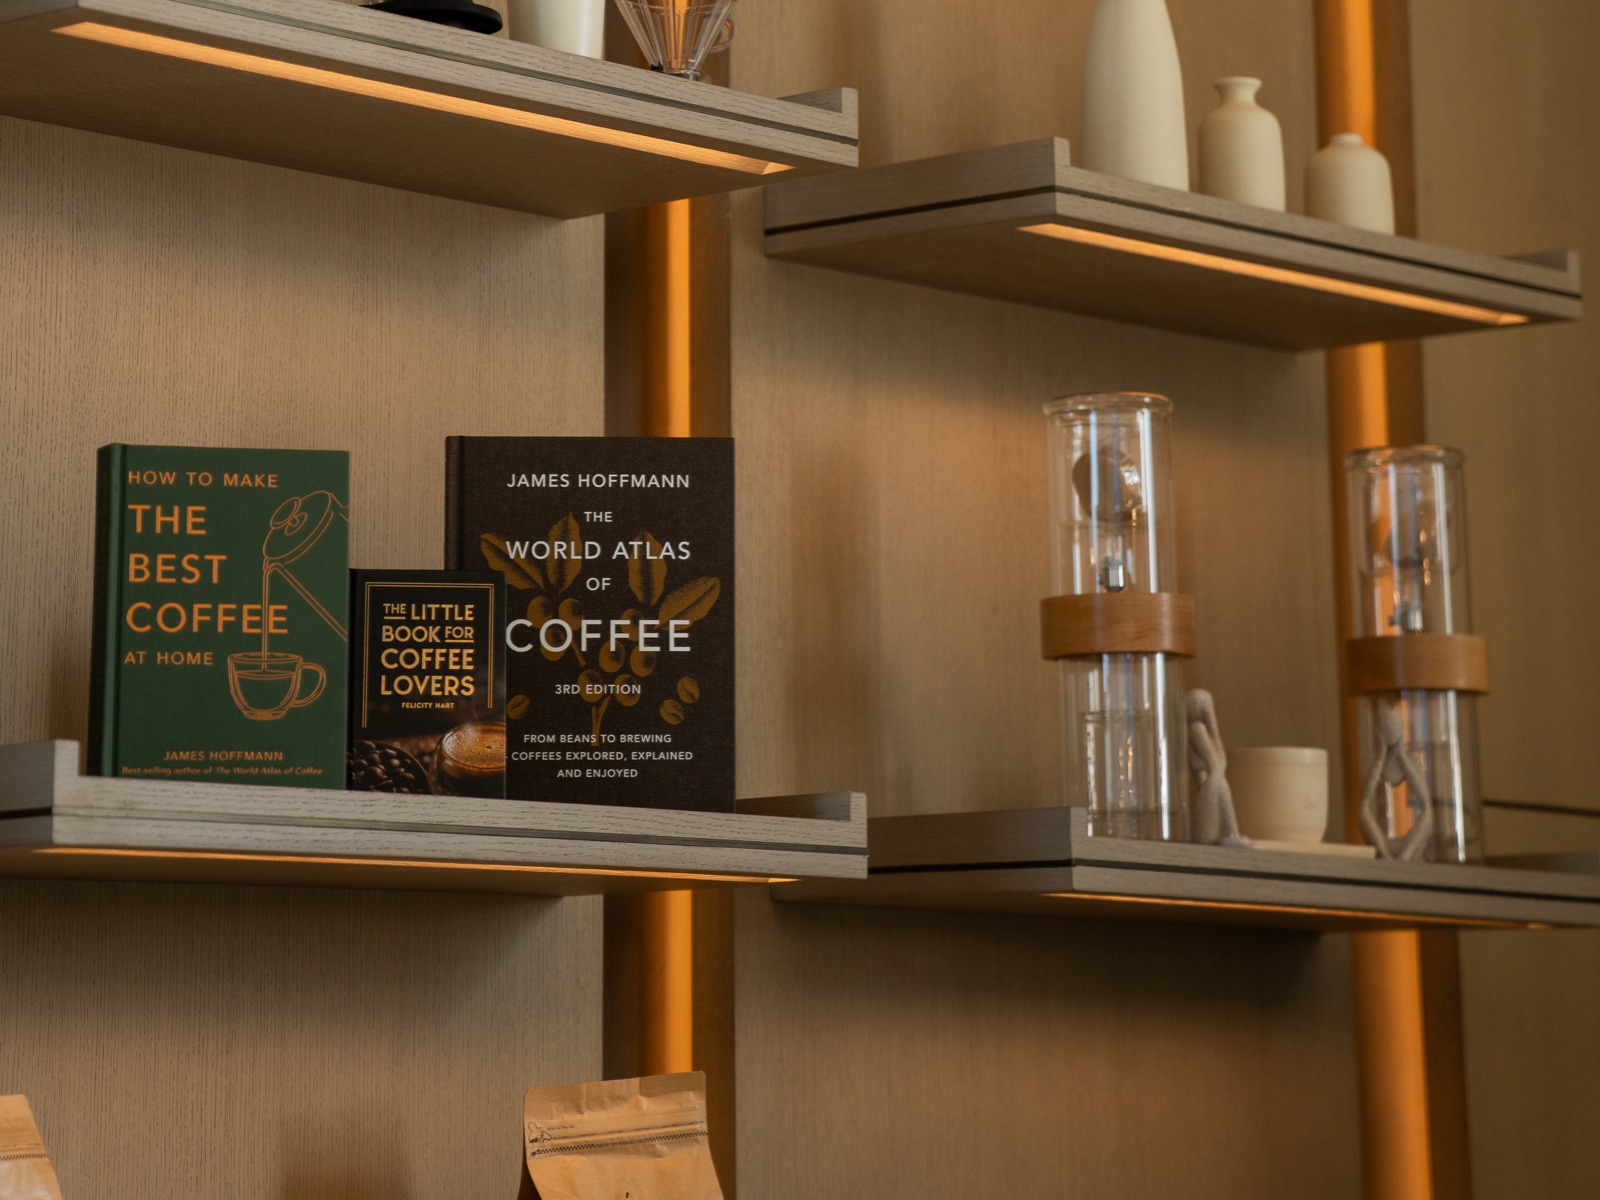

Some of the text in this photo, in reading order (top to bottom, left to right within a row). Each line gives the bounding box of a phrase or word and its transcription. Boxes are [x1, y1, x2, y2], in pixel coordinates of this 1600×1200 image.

[128, 470, 278, 489] HOW TO MAKE
[506, 473, 690, 488] JAMES HOFFMANN
[127, 504, 207, 536] THE
[583, 511, 613, 523] THE
[505, 540, 691, 560] WORLD ATLAS
[128, 553, 227, 585] BEST
[585, 577, 611, 591] OF
[126, 601, 288, 634] COFFEE
[383, 603, 475, 621] THE LITTLE
[381, 625, 475, 643] BOOK FOR
[505, 618, 691, 653] COFFEE
[123, 650, 214, 666] AT HOME
[380, 647, 475, 671] COFFEE
[380, 674, 475, 697] LOVERS
[554, 683, 641, 695] 3RD EDITION
[401, 701, 433, 709] FELICITY
[523, 733, 672, 744] FROM BEANS TO BREWING
[163, 750, 284, 761] JAMES HOFFMANN
[511, 751, 694, 762] COFFEES EXPLORED, EXPLAINED
[121, 765, 323, 776] Best-selling author of The World Atlas of Coffee
[556, 768, 639, 778] AND ENJOYED
